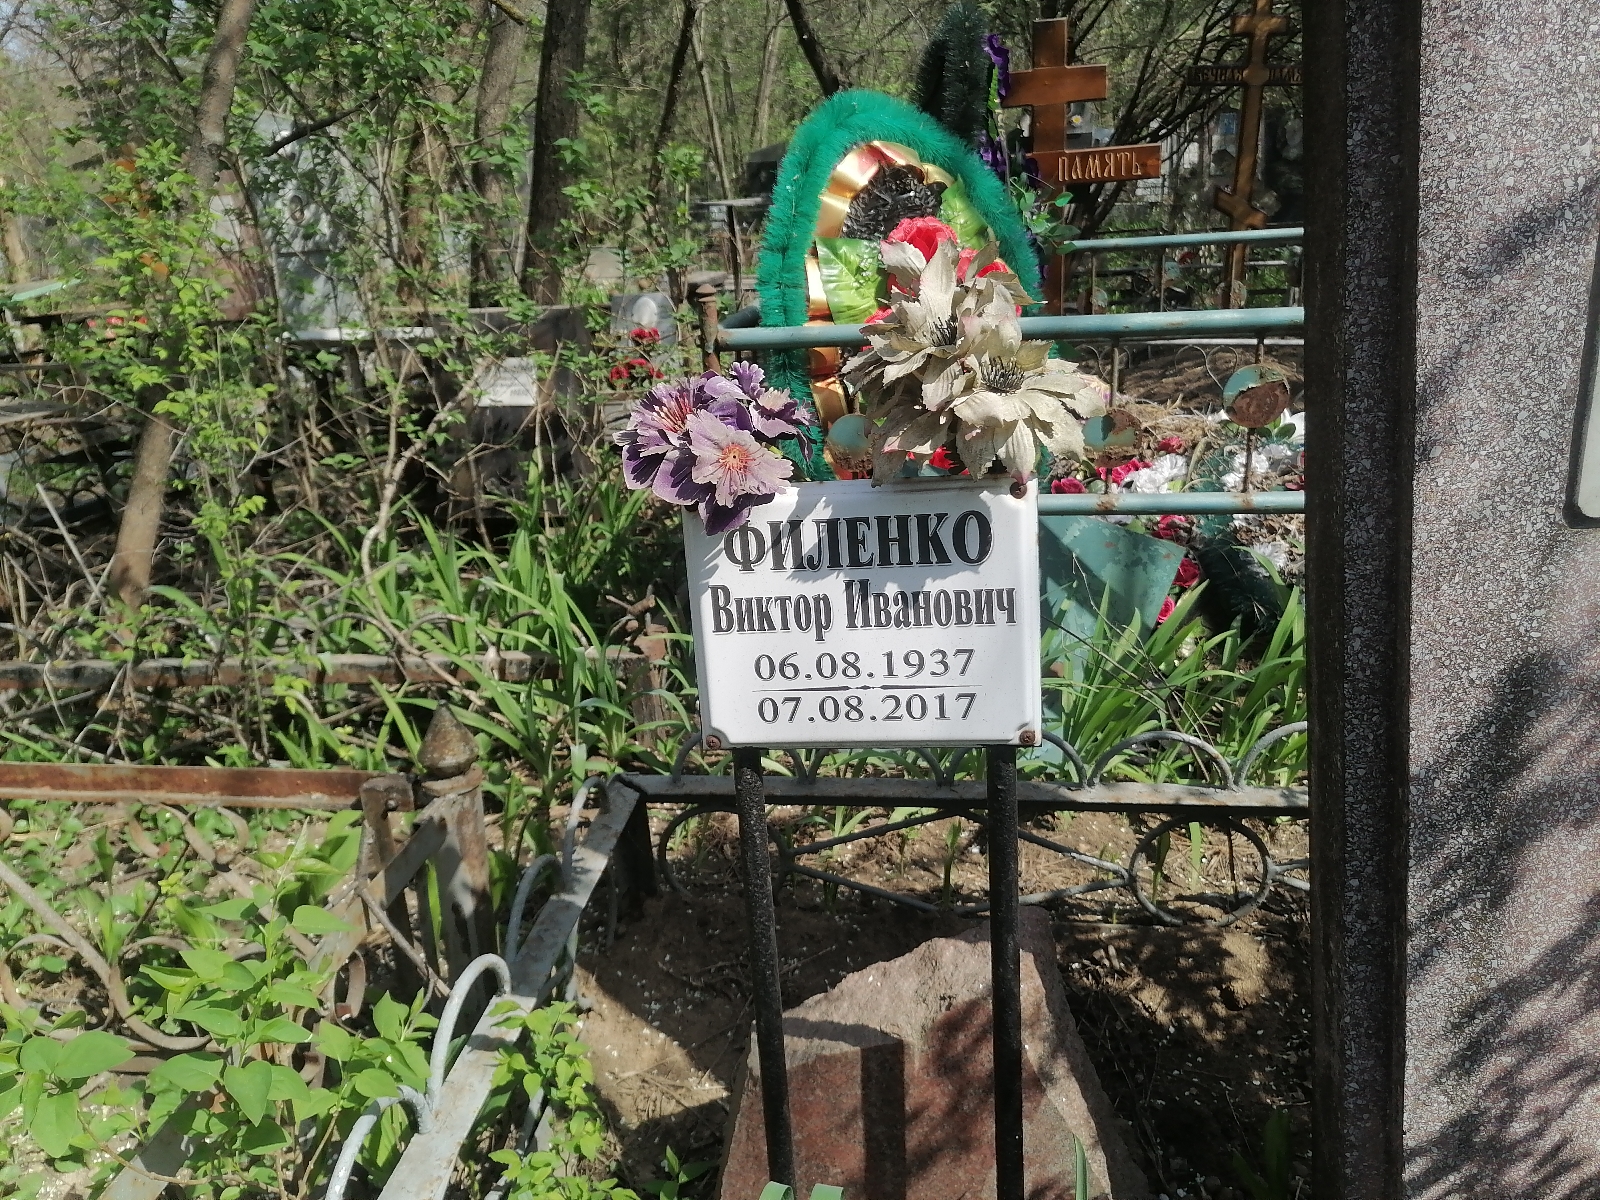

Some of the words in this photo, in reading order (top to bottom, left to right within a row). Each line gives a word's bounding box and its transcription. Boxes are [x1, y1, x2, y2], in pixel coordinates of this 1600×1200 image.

[1058, 151, 1142, 182] ПАМЯТЬ
[723, 510, 993, 573] ФИЛЕНКО
[708, 584, 834, 642] Виктор
[843, 578, 1017, 630] Иванович
[753, 648, 976, 681] 06.08.1937
[757, 692, 978, 724] 07.08.2017
